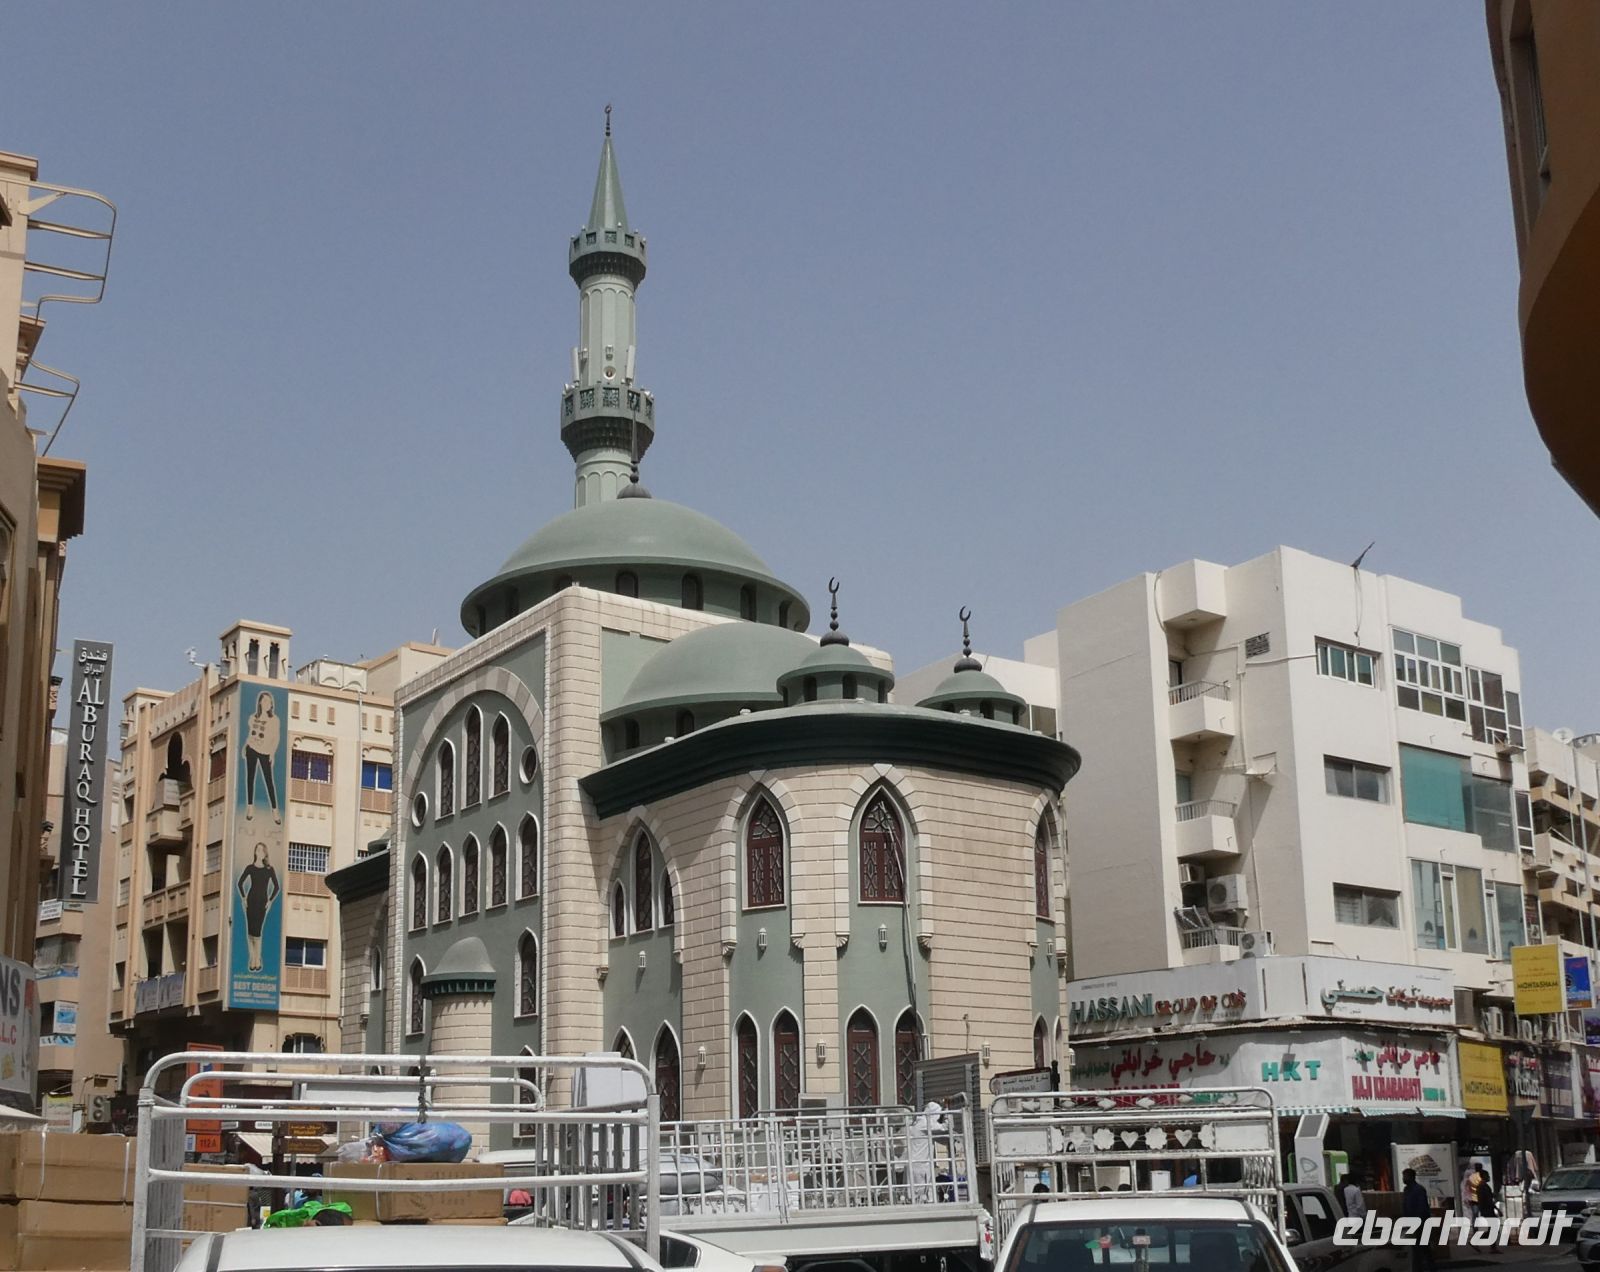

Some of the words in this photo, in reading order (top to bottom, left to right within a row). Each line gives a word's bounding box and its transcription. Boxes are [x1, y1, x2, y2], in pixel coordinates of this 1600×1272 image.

[78, 647, 108, 662] فندق
[76, 678, 105, 705] AL
[77, 704, 98, 804] BURAQ
[71, 808, 91, 896] HOTEL
[1070, 993, 1153, 1025] HASSANI
[1155, 997, 1197, 1015] GROUP
[1261, 1060, 1321, 1082] HKT
[1352, 1075, 1373, 1100] HAJI
[1373, 1076, 1422, 1101] KHARABATI
